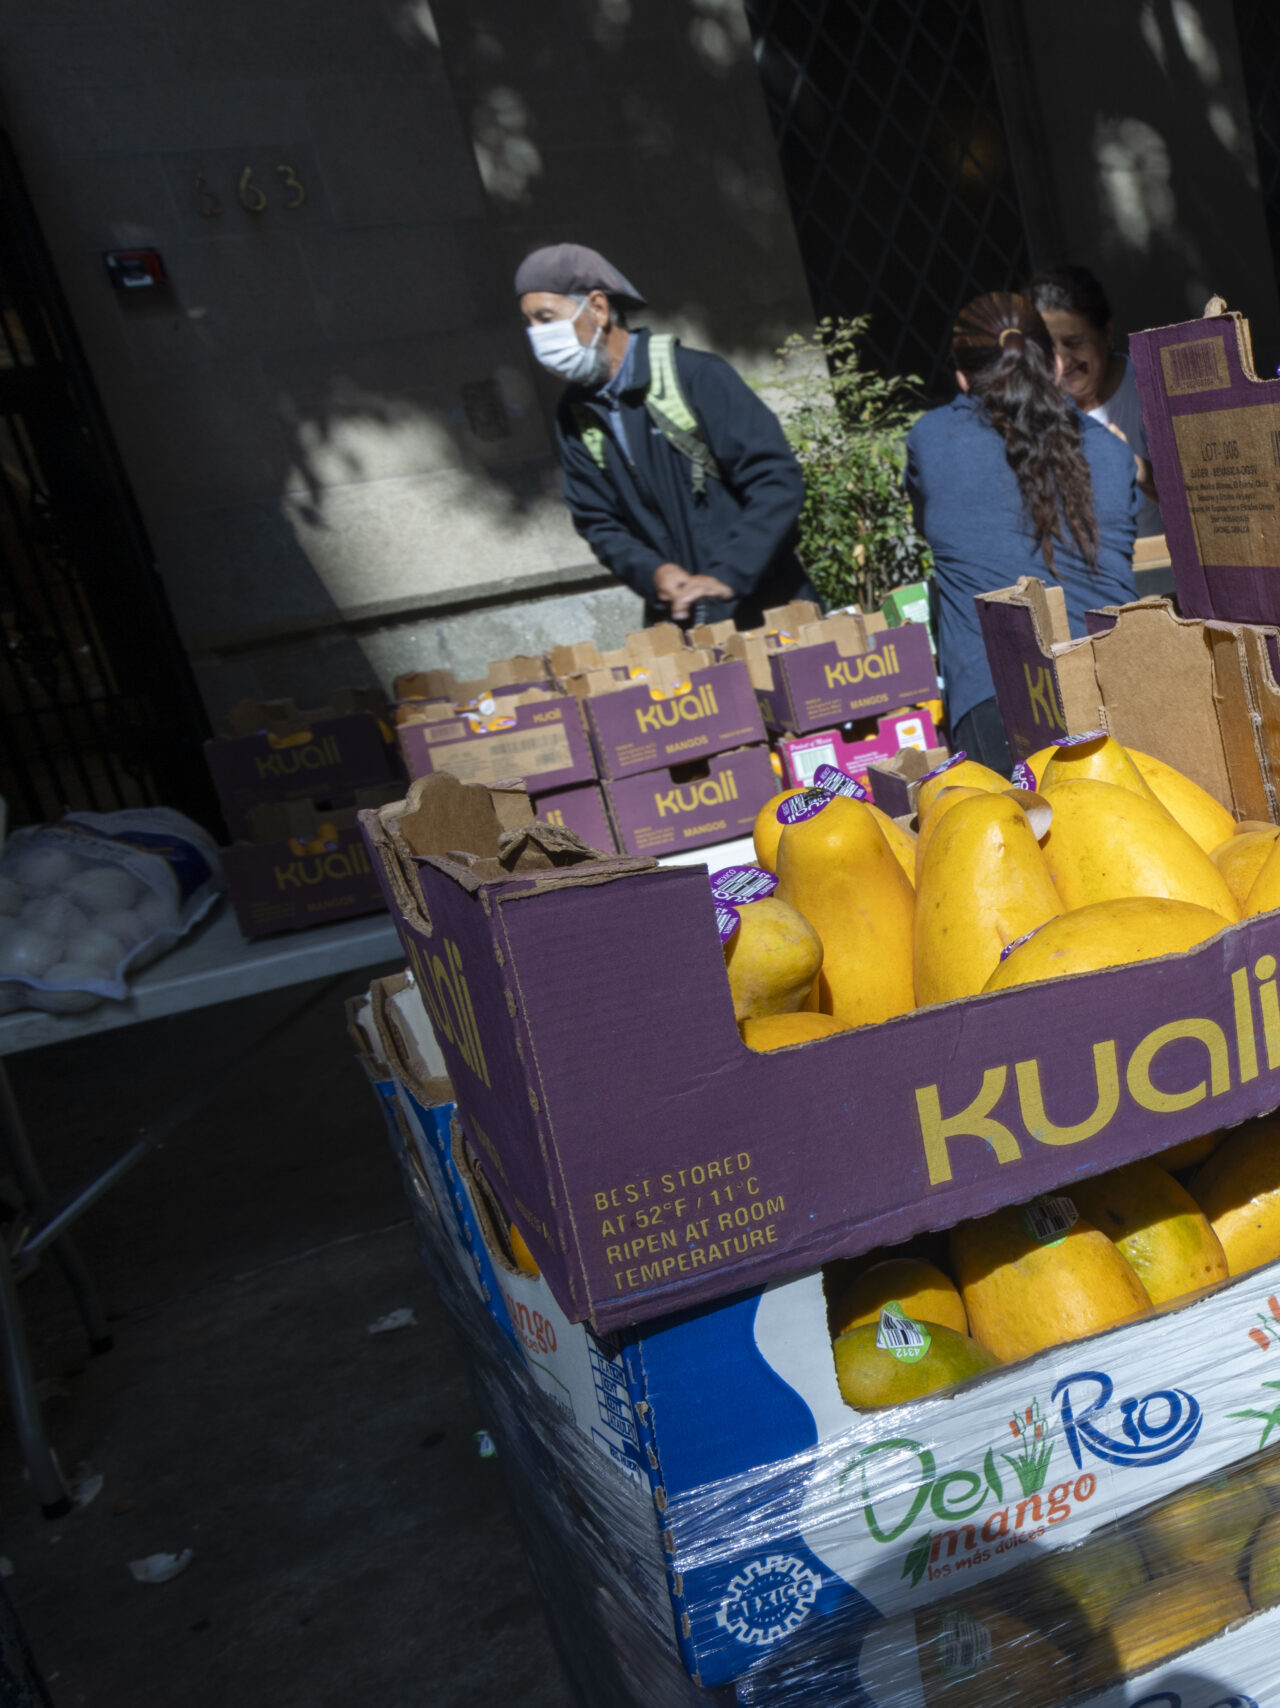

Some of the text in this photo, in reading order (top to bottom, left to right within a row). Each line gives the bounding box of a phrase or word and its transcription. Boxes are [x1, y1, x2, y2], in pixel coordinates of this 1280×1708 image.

[824, 644, 900, 688] Kuali
[635, 683, 720, 733] Kuali
[850, 693, 889, 709] MANGOS
[665, 735, 708, 754] MANGOS
[654, 769, 739, 817] Kuali
[683, 819, 727, 838] MANGOS
[714, 869, 738, 888] MEXICO
[747, 868, 772, 881] 4312
[714, 906, 729, 916] 43
[594, 1152, 751, 1211] BEST STORED
[602, 1214, 626, 1237] AT
[636, 1198, 687, 1228] 52°F
[710, 1176, 760, 1206] 11°C
[606, 1195, 785, 1265] RIPEN AT ROOM
[614, 1224, 778, 1290] TEMPERATURE
[895, 1348, 920, 1358] 4312
[1052, 1371, 1204, 1471] Rio
[928, 1473, 1098, 1563] mango
[927, 1524, 1046, 1582] los más dulces
